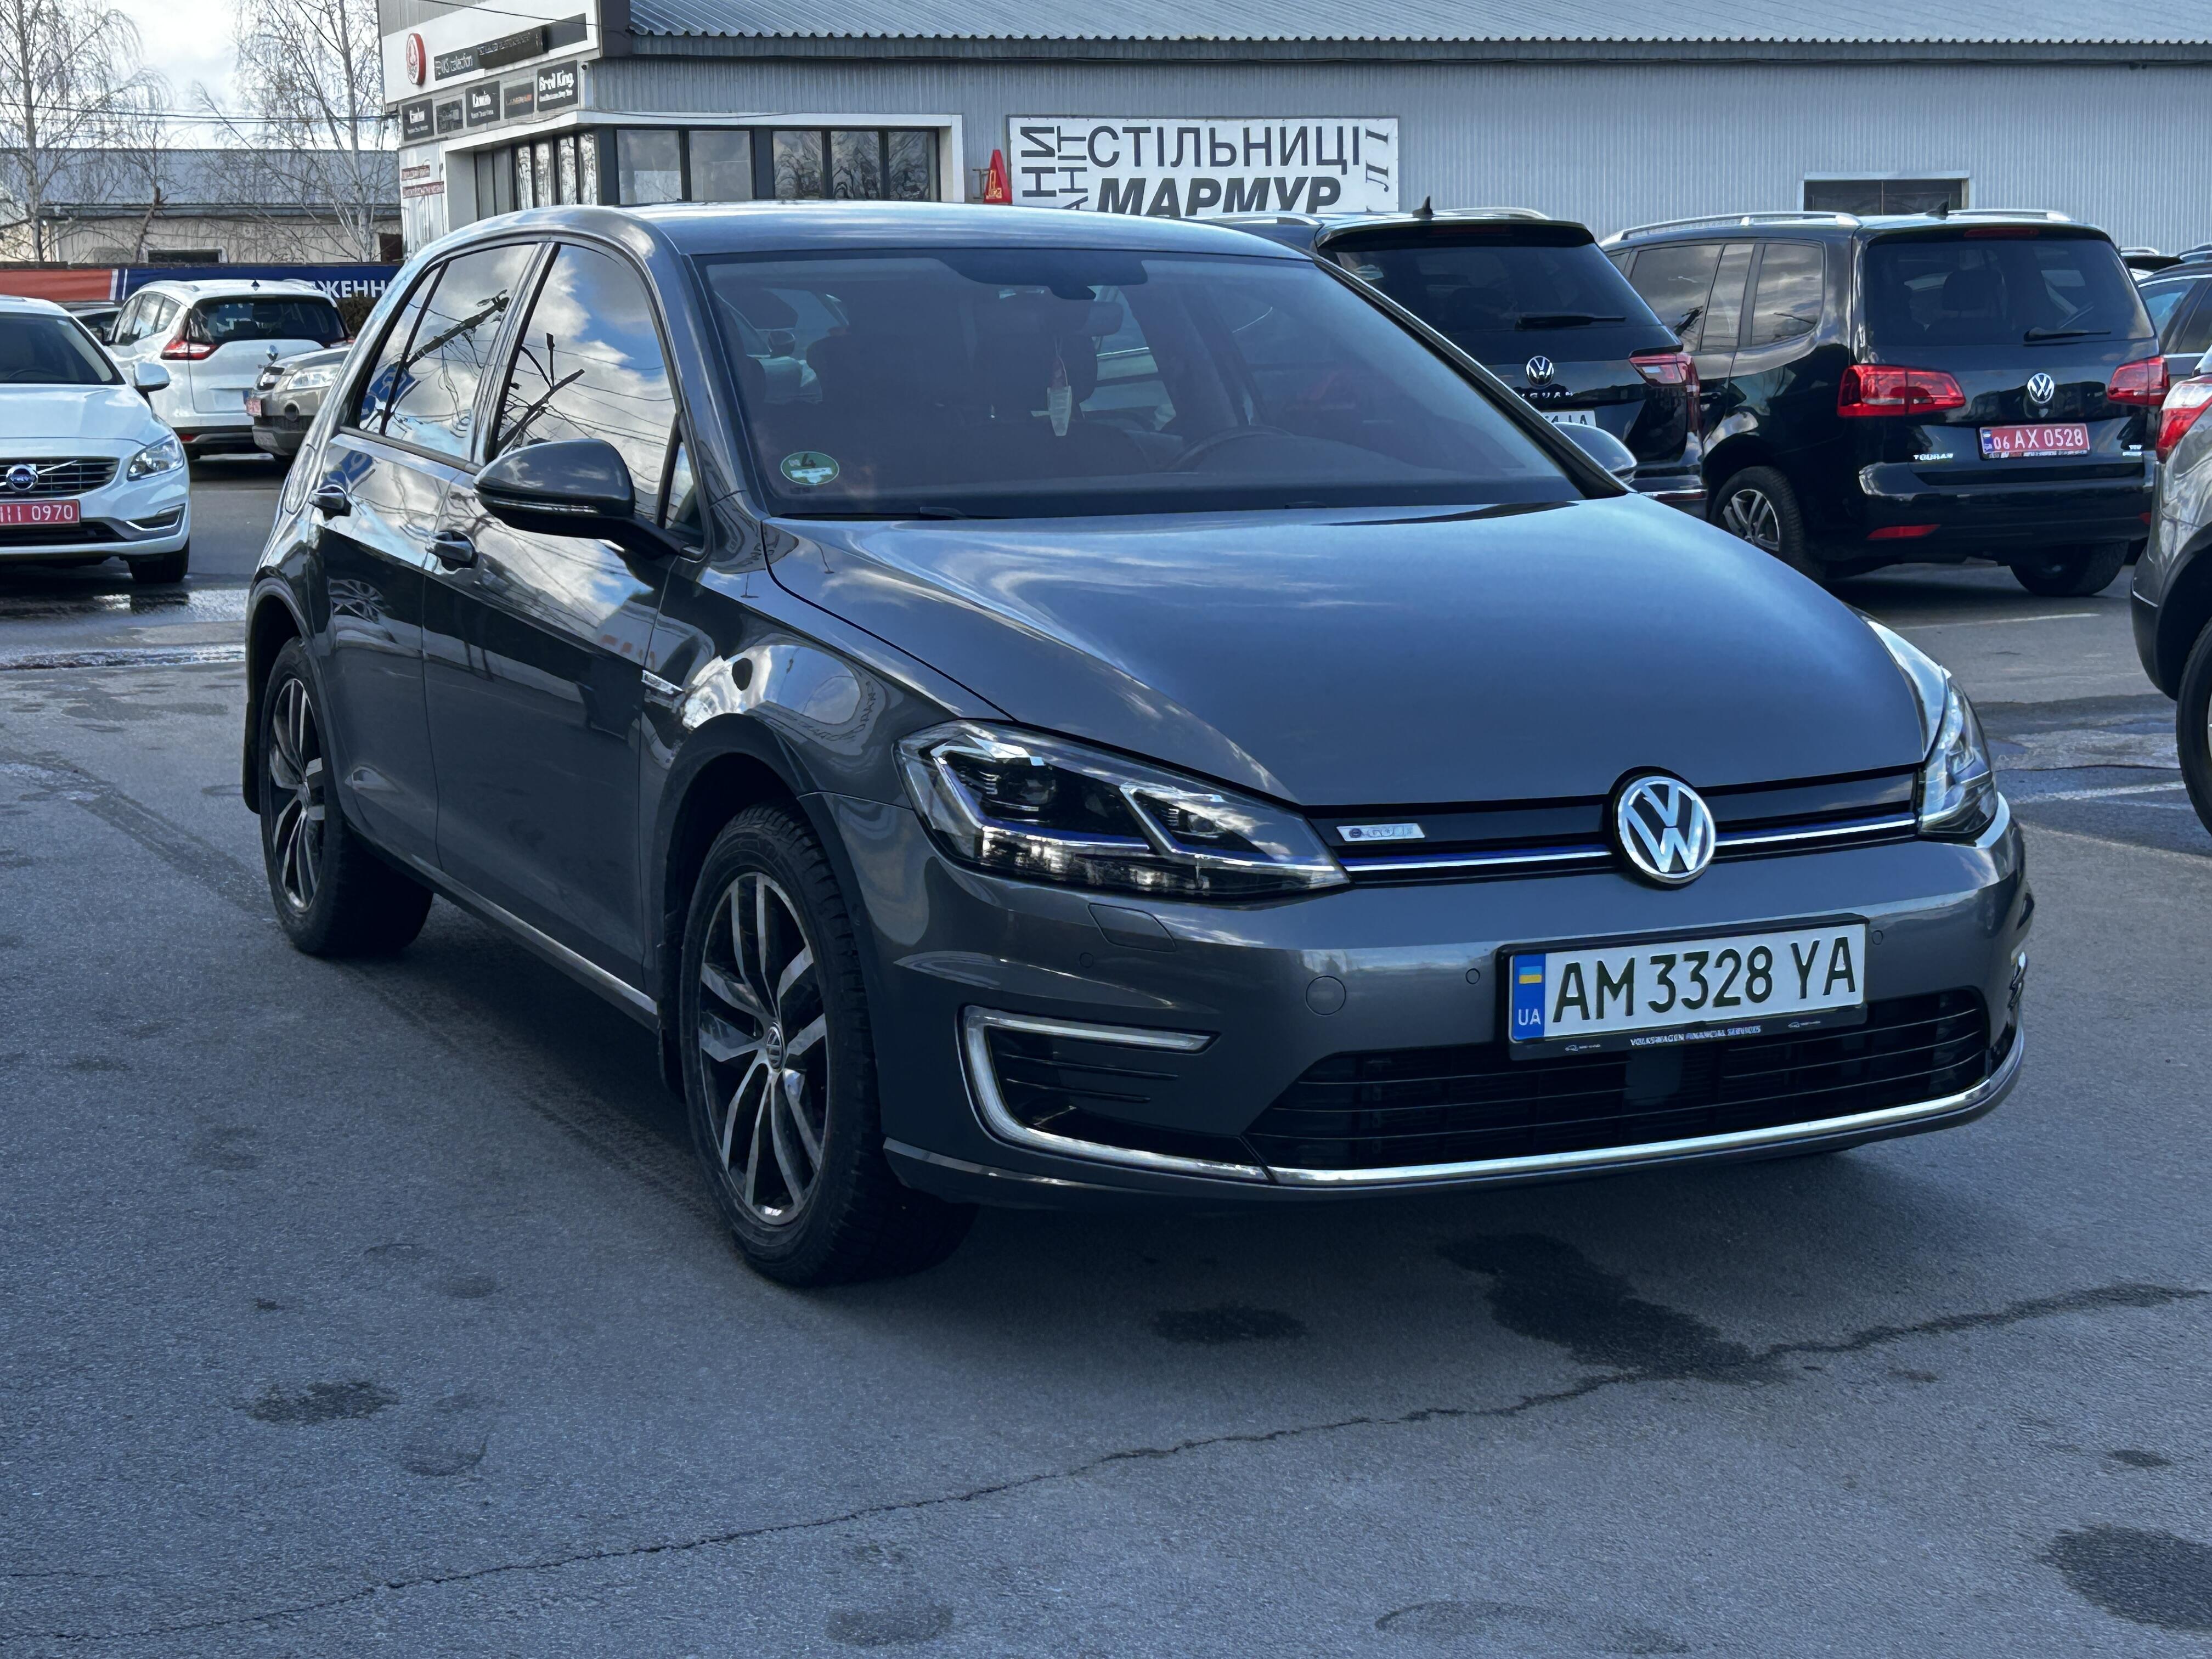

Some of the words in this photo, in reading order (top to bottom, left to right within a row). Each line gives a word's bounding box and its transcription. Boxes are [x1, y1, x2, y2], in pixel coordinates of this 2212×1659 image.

[1087, 126, 1359, 175] СТІЛЬНИЦІ
[1097, 176, 1341, 218] МАРМУР
[1993, 436, 2010, 450] 06
[2015, 429, 2040, 449] AX
[2044, 428, 2084, 448] 0528
[32, 504, 73, 521] 0970
[1618, 776, 1716, 879] VW
[1553, 957, 1635, 1023] AM
[1647, 945, 1773, 1013] 3328
[1790, 936, 1857, 1000] YA
[1517, 1008, 1542, 1026] UA
